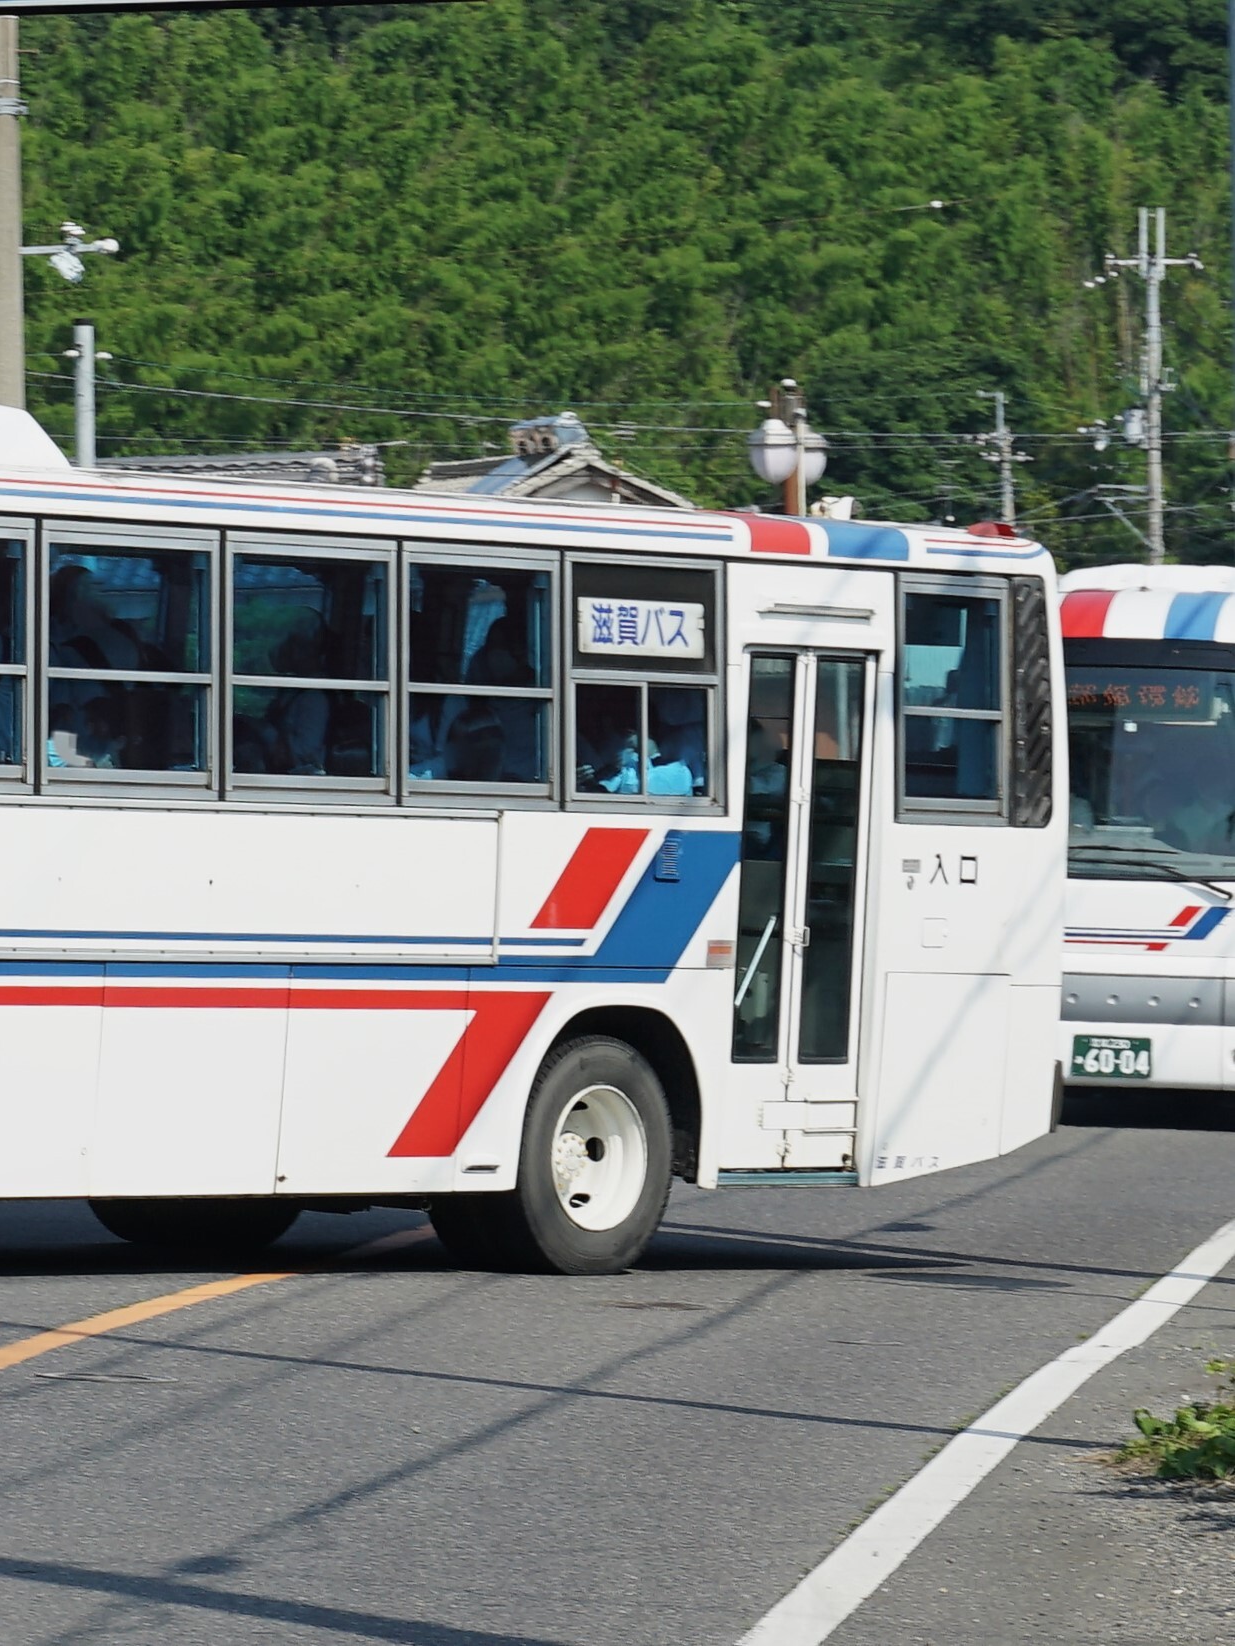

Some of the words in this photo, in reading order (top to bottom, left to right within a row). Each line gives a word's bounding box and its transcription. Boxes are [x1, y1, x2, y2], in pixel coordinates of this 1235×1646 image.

[591, 602, 690, 648] 滋賀バス
[929, 853, 978, 885] 入口
